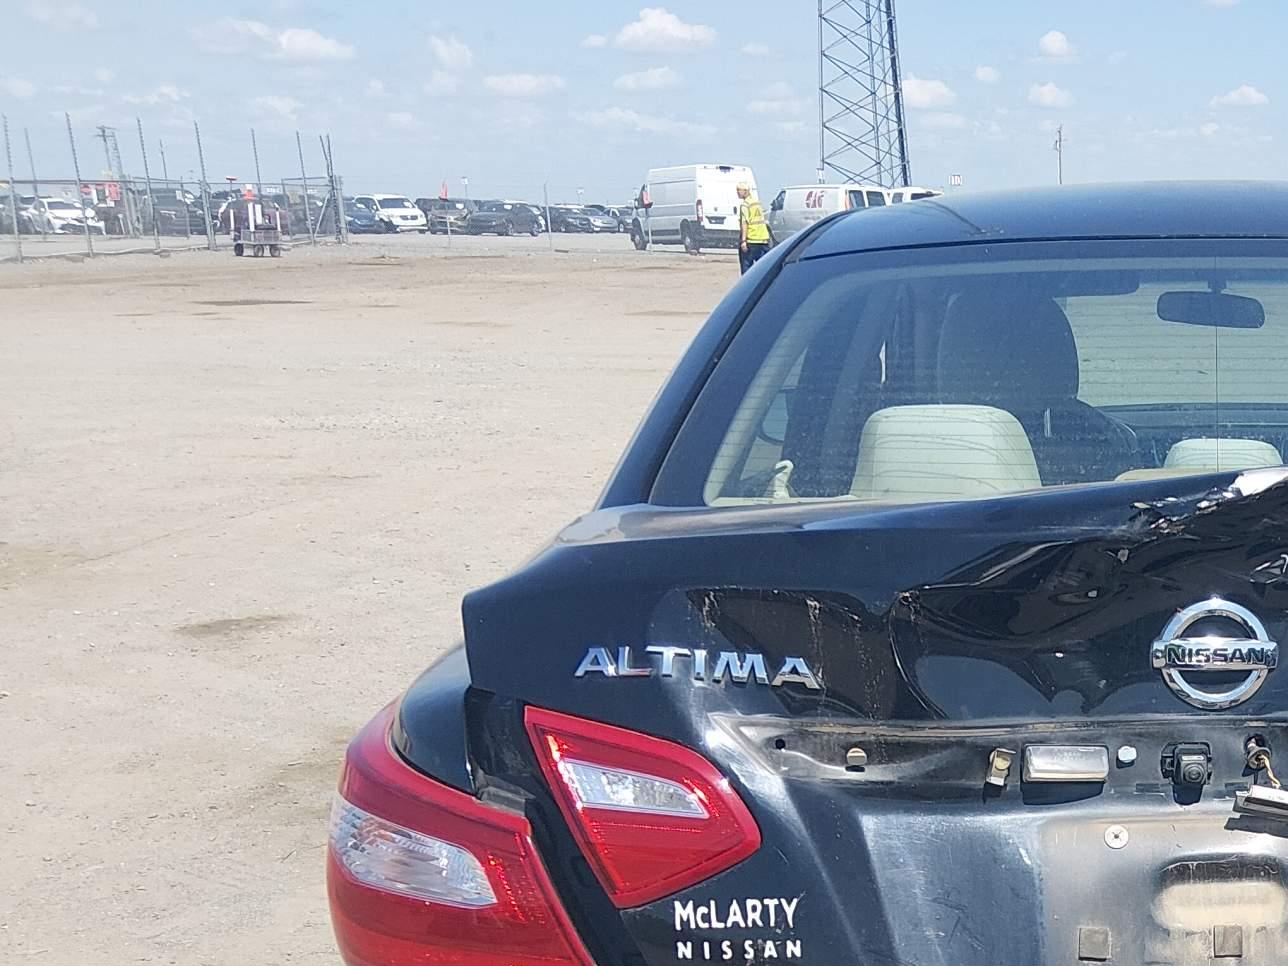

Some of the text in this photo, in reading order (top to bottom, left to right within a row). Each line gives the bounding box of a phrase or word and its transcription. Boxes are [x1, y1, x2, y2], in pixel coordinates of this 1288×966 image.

[574, 645, 821, 690] ALTIMA
[1167, 647, 1265, 663] NISSAN
[674, 898, 798, 931] McLARTY
[676, 939, 802, 960] NISSAN
